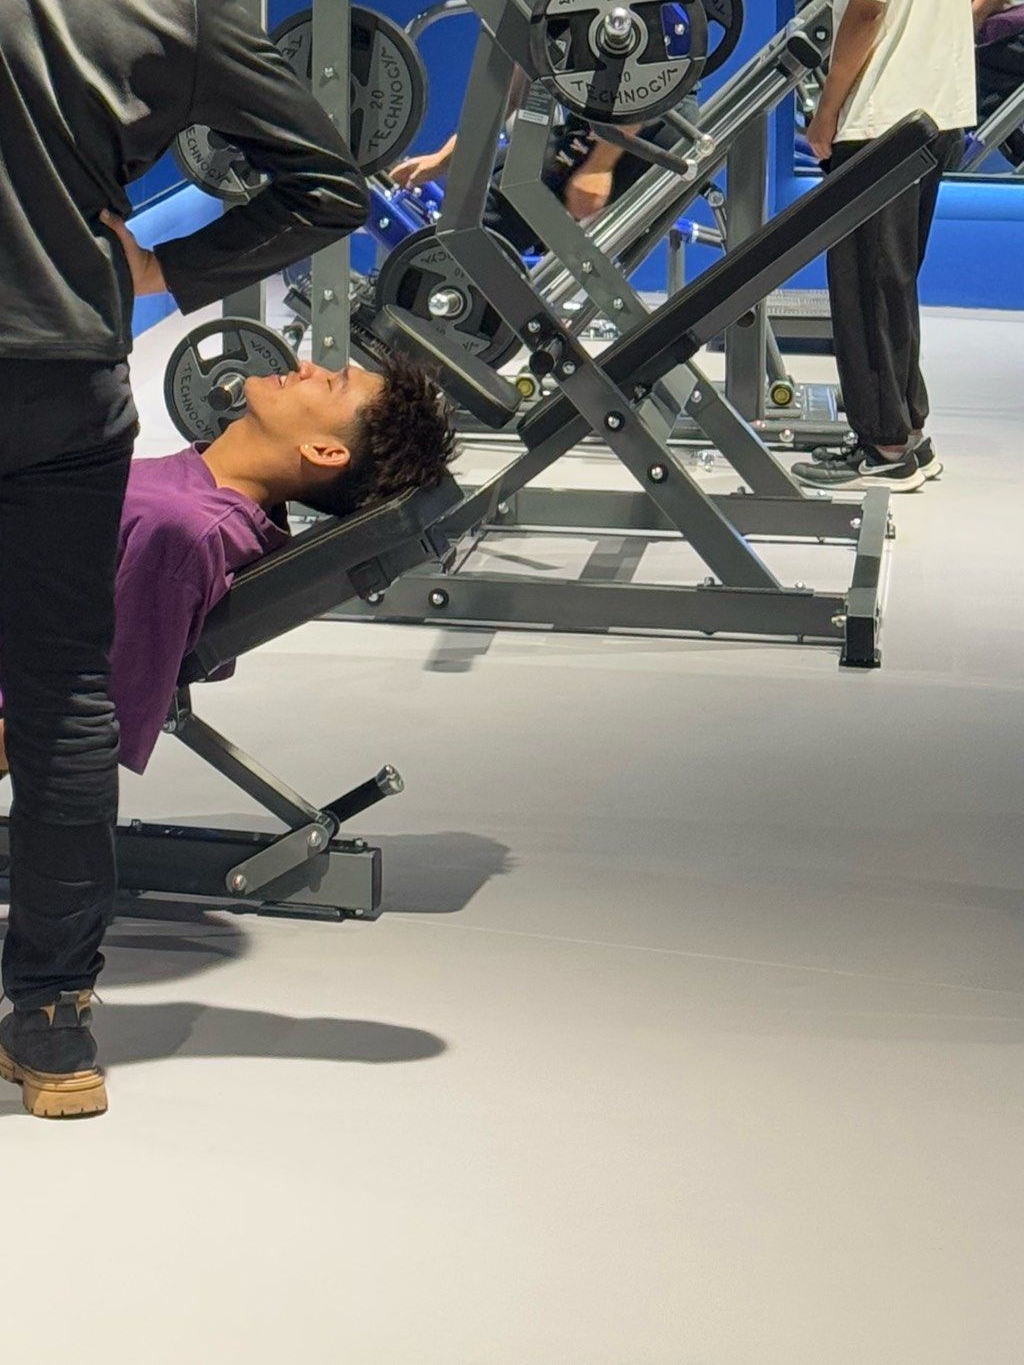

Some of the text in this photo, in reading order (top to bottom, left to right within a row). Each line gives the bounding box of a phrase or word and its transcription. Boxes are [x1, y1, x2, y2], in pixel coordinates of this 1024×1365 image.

[368, 46, 404, 152] TECHNOGYM
[370, 90, 385, 109] 20
[186, 126, 232, 184] ECHNOGYM
